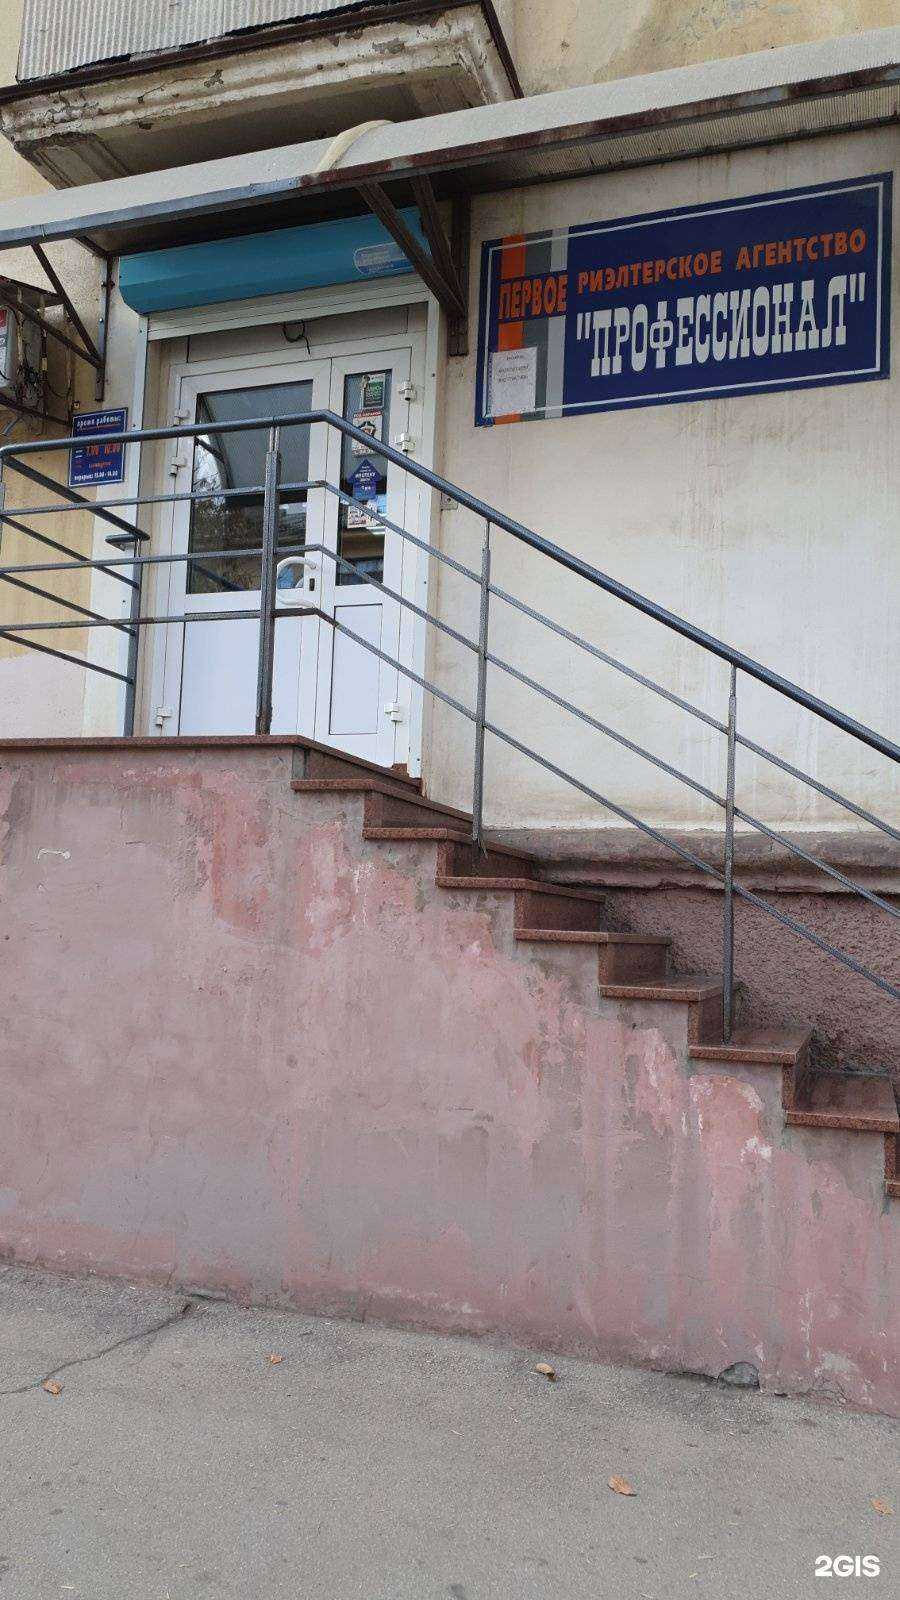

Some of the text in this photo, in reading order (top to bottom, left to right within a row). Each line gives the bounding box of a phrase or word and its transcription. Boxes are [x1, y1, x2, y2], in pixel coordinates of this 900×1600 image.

[498, 228, 867, 320] ПЕРВОЕ РИЭЛТЕРСКОЕ АГЕНТСТВО
[576, 272, 866, 377] "ПРОФЕССИОНАЛ"
